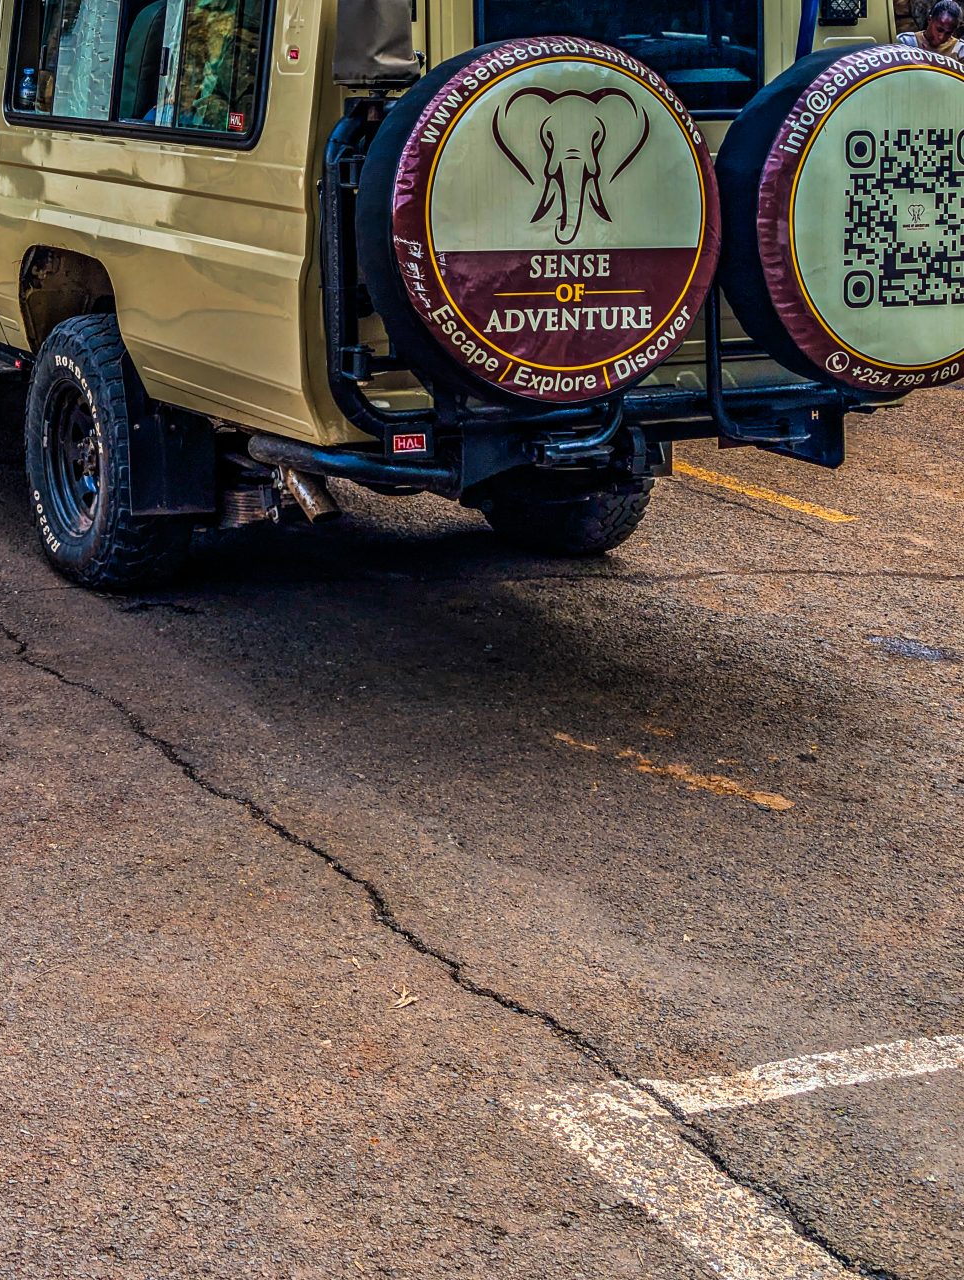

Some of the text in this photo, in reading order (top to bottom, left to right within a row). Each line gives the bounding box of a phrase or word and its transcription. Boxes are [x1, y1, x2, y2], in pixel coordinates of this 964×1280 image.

[420, 40, 702, 145] www.senseofadventure.co.ke
[529, 253, 611, 279] SENSE
[555, 283, 585, 303] OF
[483, 305, 653, 333] ADVENTURE
[431, 304, 500, 372] Escape
[613, 305, 692, 380] Discover
[513, 365, 598, 395] Explore
[851, 362, 960, 387] +254 799 160
